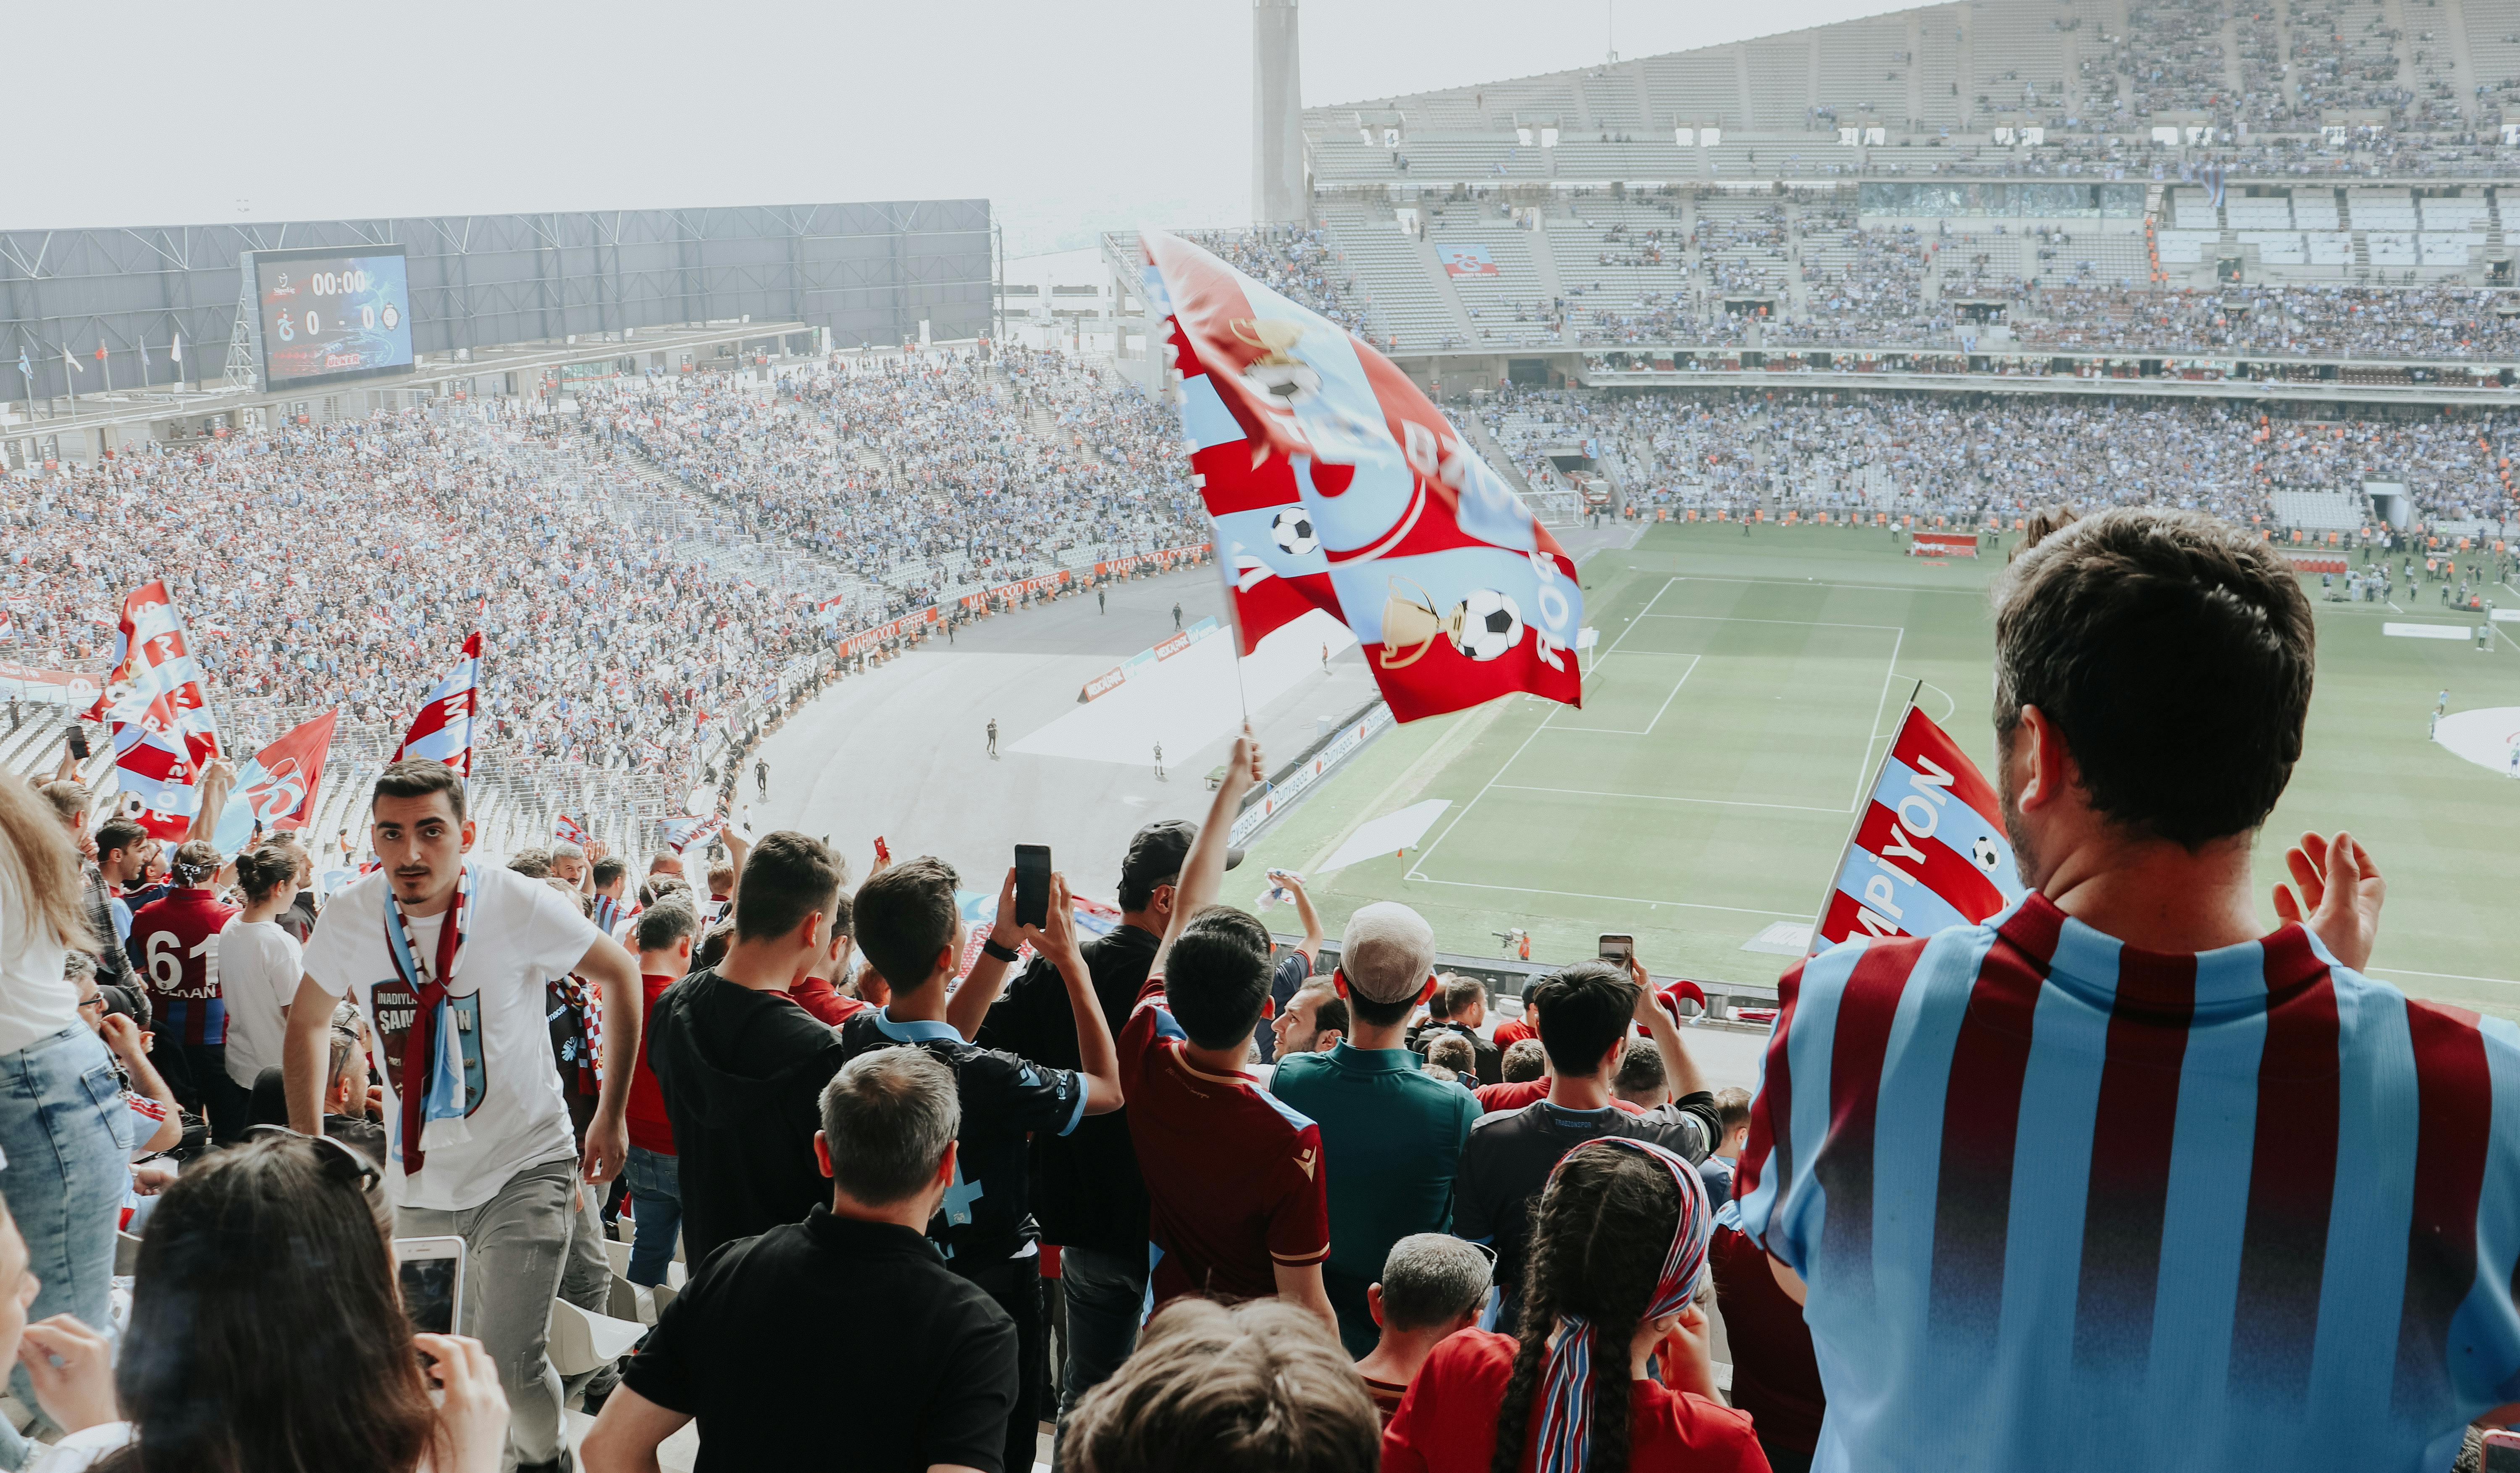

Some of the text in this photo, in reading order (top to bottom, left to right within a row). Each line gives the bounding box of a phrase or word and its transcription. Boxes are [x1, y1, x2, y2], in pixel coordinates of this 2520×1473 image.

[312, 270, 366, 296] 00:00
[306, 310, 320, 335] 0
[362, 305, 375, 330] 0
[326, 353, 360, 368] ÜLKER
[1027, 573, 1060, 592] COFFEE
[848, 623, 896, 656] MAHMOOD
[146, 930, 220, 990] 61
